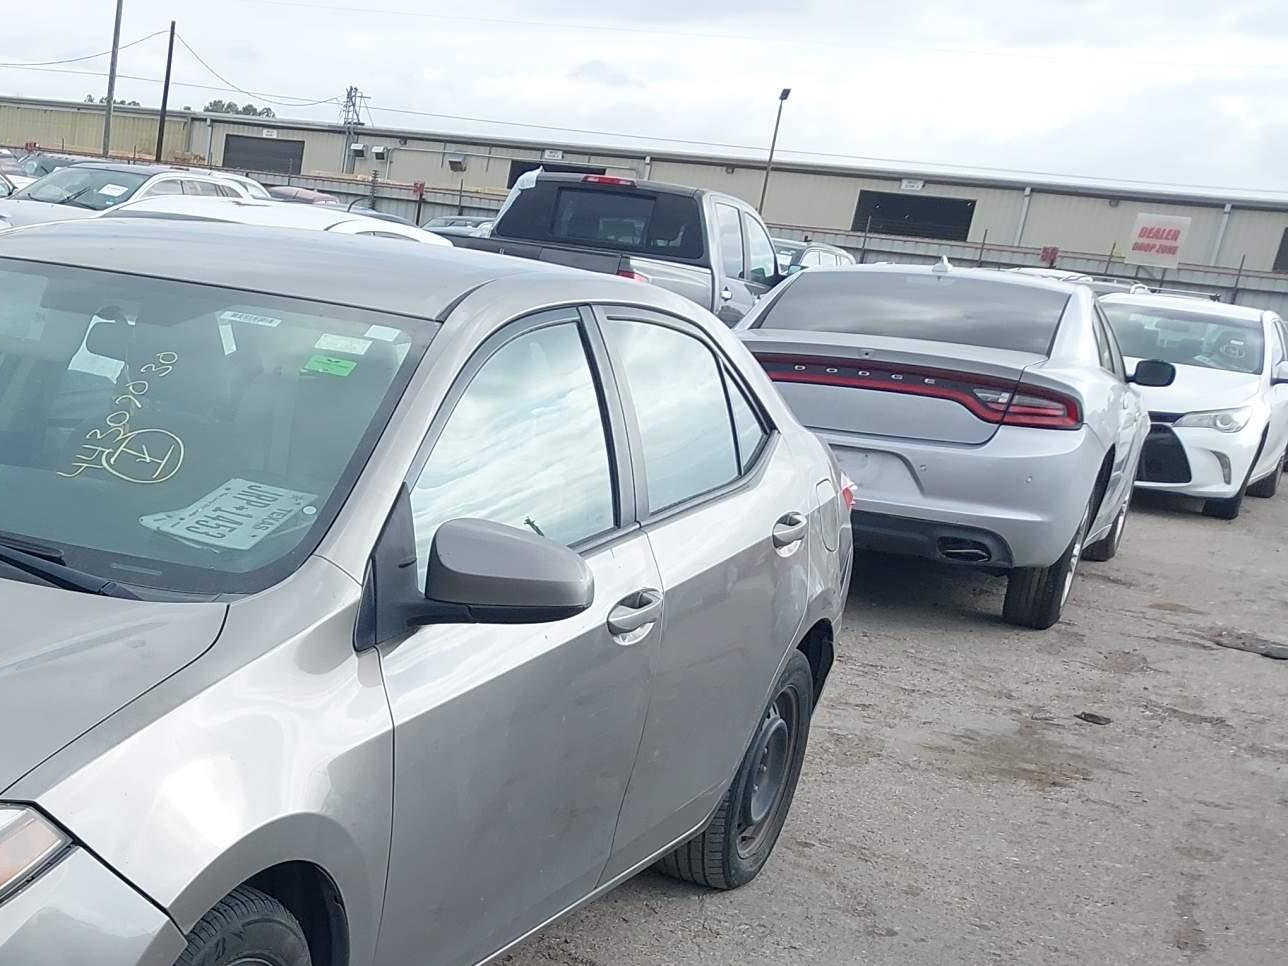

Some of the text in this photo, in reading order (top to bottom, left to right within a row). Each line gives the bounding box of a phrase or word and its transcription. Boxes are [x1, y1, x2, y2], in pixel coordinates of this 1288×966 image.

[1138, 226, 1181, 241] DEALER
[794, 364, 936, 384] DODGE
[253, 508, 295, 532] TEXAS
